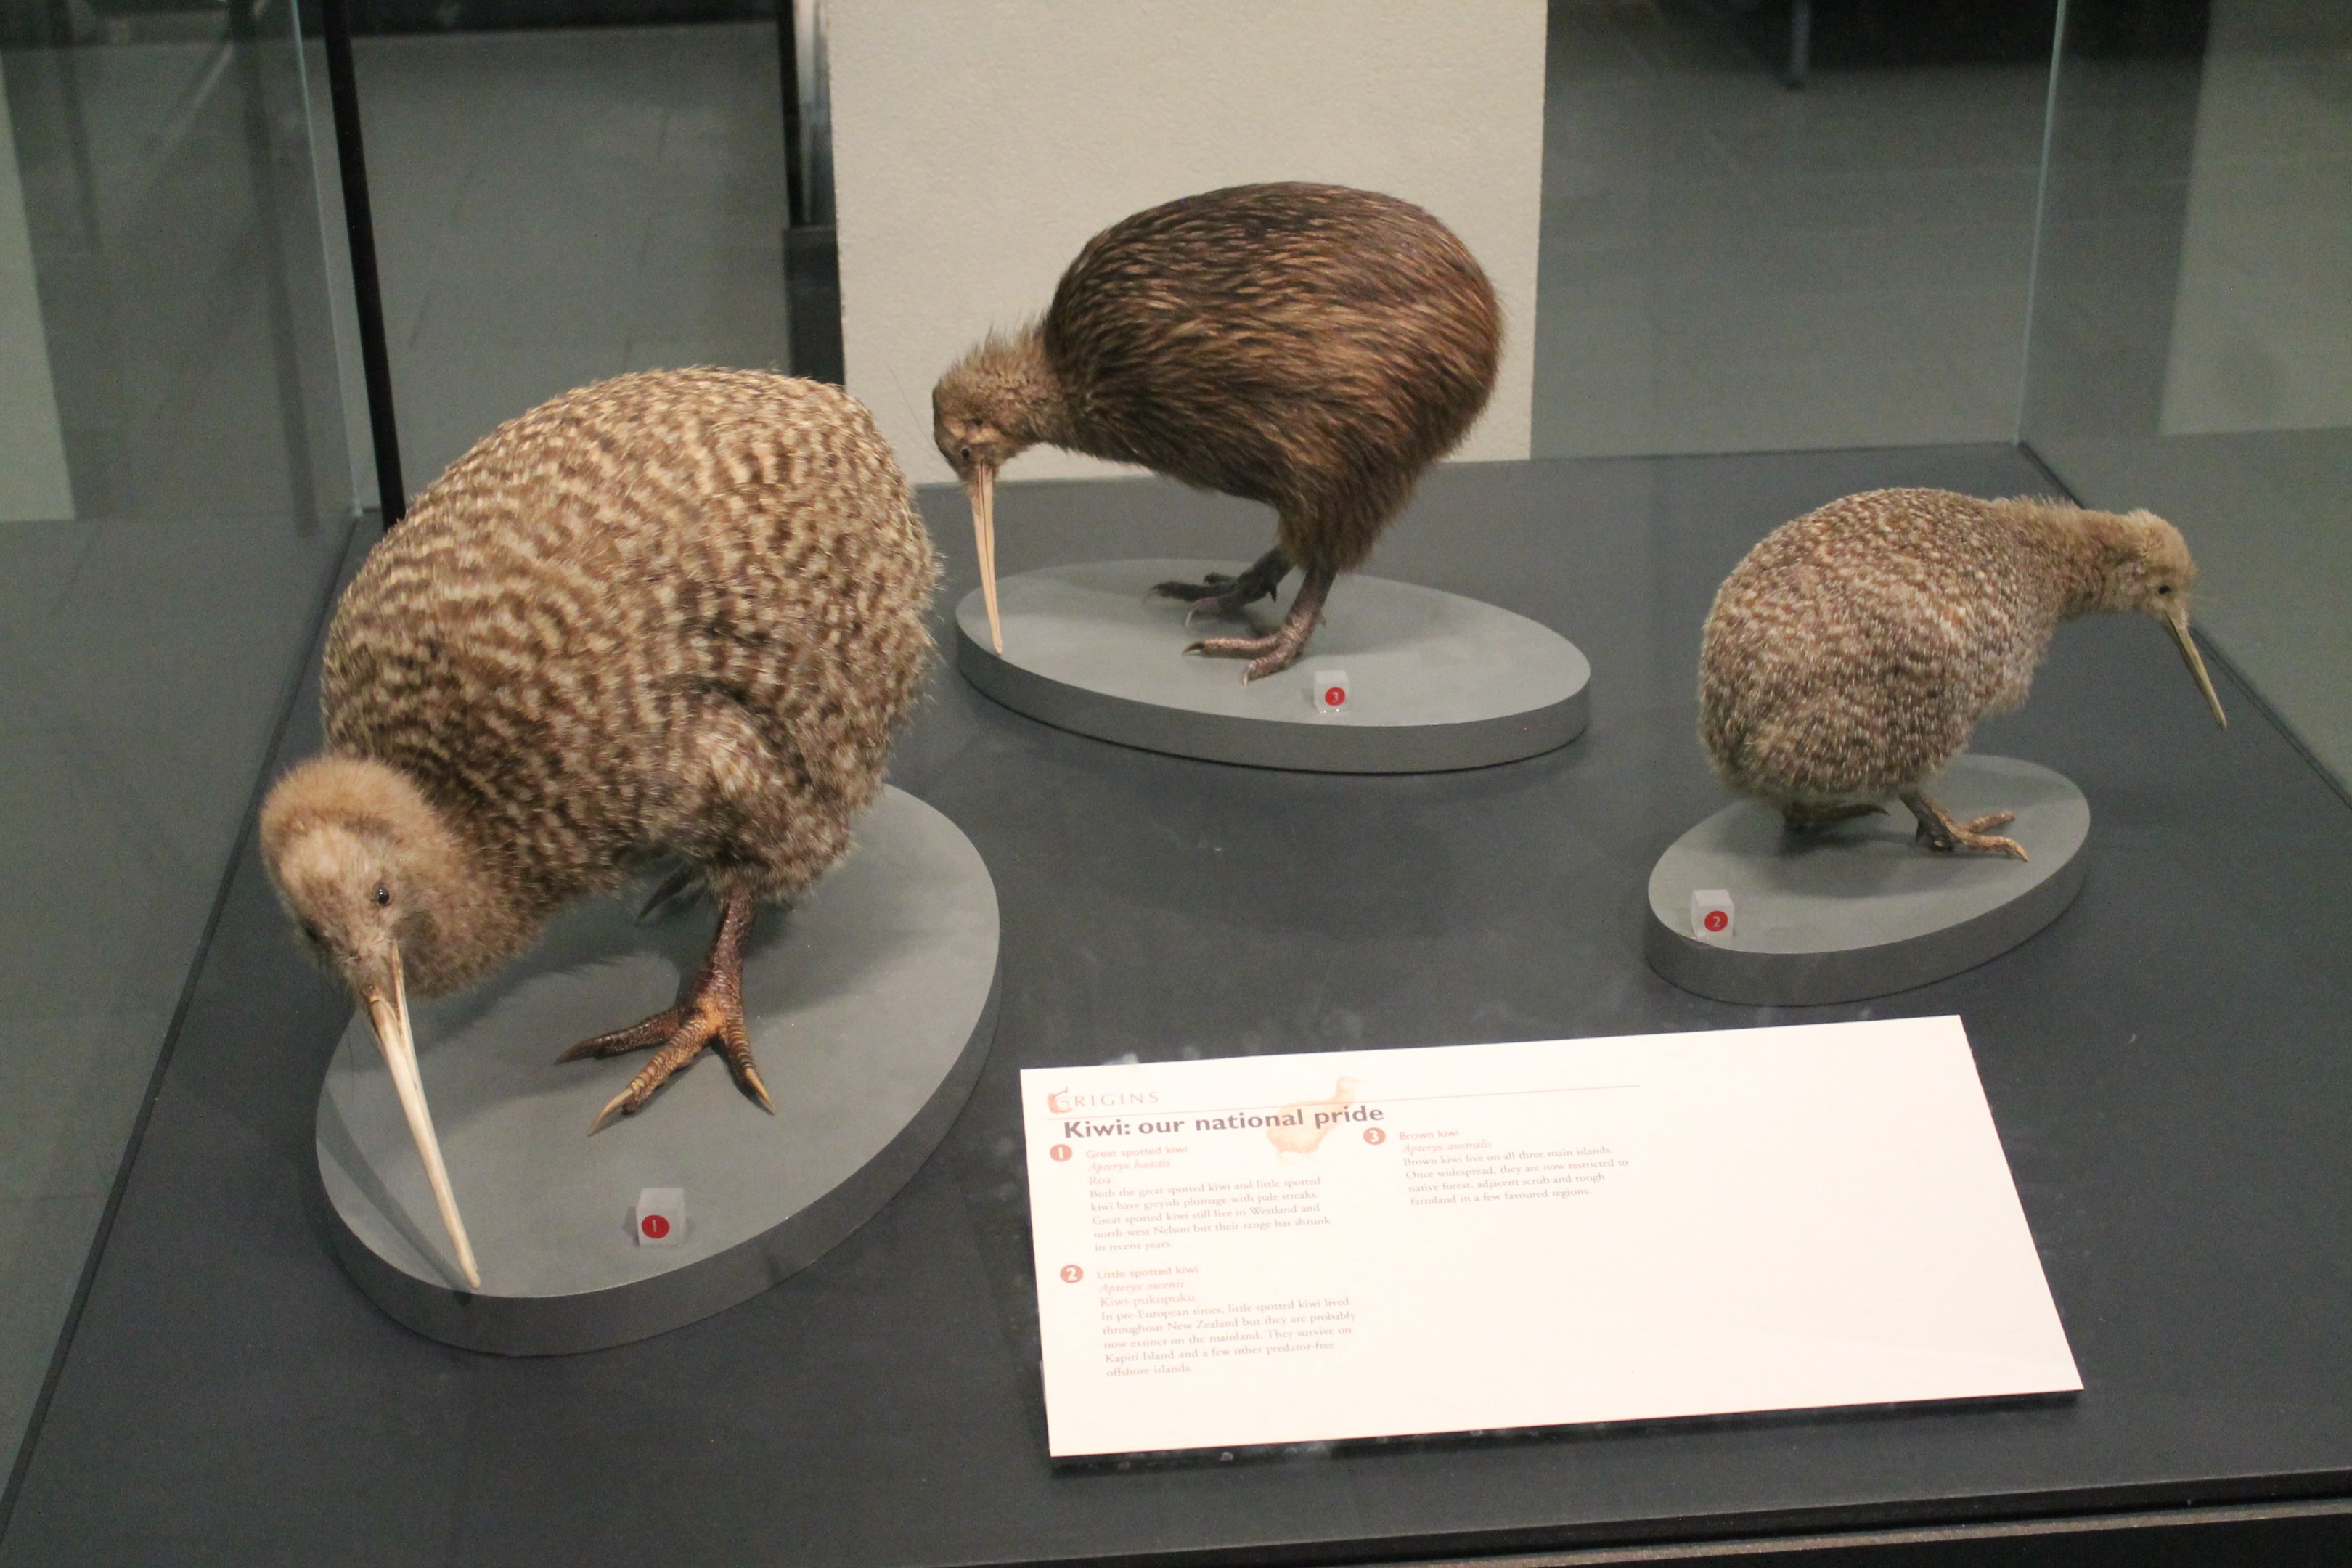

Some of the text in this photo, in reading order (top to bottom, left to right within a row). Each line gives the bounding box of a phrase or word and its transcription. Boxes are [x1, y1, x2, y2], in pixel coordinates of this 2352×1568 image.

[1064, 1105, 1384, 1138] Kiwi: our national pride
[1398, 1127, 1434, 1140] Brown
[1437, 1126, 1459, 1138] kiwi
[1086, 1146, 1116, 1159] Great
[1121, 1144, 1161, 1159] spotted
[1164, 1143, 1188, 1154] kiwi
[1402, 1138, 1493, 1156] Apteryx australis
[1402, 1153, 1437, 1166] Brown
[1440, 1152, 1463, 1164] kiwi
[1465, 1151, 1484, 1162] live
[1503, 1149, 1516, 1160] all
[1519, 1148, 1543, 1159] three
[1548, 1146, 1574, 1157] main
[1577, 1143, 1613, 1156] islands.
[1087, 1156, 1170, 1175] Apteryx haastii
[1405, 1167, 1433, 1179] Once
[1437, 1164, 1497, 1180] widespread,
[1500, 1162, 1522, 1177] they
[1543, 1162, 1565, 1171] now
[1568, 1156, 1614, 1169] restricted
[1617, 1156, 1629, 1167] to
[1089, 1174, 1112, 1185] Roa
[1089, 1175, 1321, 1198] Both the great spotted kiwi and little spotted
[1408, 1170, 1606, 1192] native forest, adjacent scrub and rough
[1090, 1188, 1318, 1212] kiwi have greyish plumage with pale streaks.
[1411, 1193, 1456, 1206] farmland
[1459, 1192, 1471, 1203] in
[1482, 1190, 1501, 1201] few
[1504, 1187, 1549, 1200] favoured
[1552, 1184, 1591, 1200] regions.
[1092, 1201, 1320, 1226] Great spotted kiwi still live in Westland and
[1093, 1214, 1330, 1238] north-west Nelson but their range has shrunk
[1095, 1238, 1173, 1251] in recent years.
[1096, 1267, 1127, 1279] Little
[1130, 1265, 1172, 1281] spotted
[1175, 1262, 1198, 1274] kiwi
[1099, 1278, 1185, 1296] Apteryx owenii
[1099, 1291, 1196, 1310] Kiwi-pukupuku
[1101, 1295, 1350, 1323] In pre-European times, little spotted kiwi lived
[1102, 1310, 1356, 1338] throughout New Zealand but they are probably
[1103, 1339, 1127, 1349] now
[1130, 1334, 1167, 1347] extinct
[1189, 1332, 1205, 1344] the
[1209, 1329, 1263, 1342] mainland.
[1265, 1327, 1294, 1342] They
[1297, 1325, 1334, 1337] survive
[1105, 1350, 1138, 1366] Kapiti
[1143, 1348, 1175, 1360] Island
[1179, 1347, 1199, 1358] and
[1211, 1344, 1231, 1356] few
[1234, 1343, 1263, 1355] other
[1266, 1339, 1334, 1356] predator-free
[1106, 1362, 1192, 1377] offshore islands.
